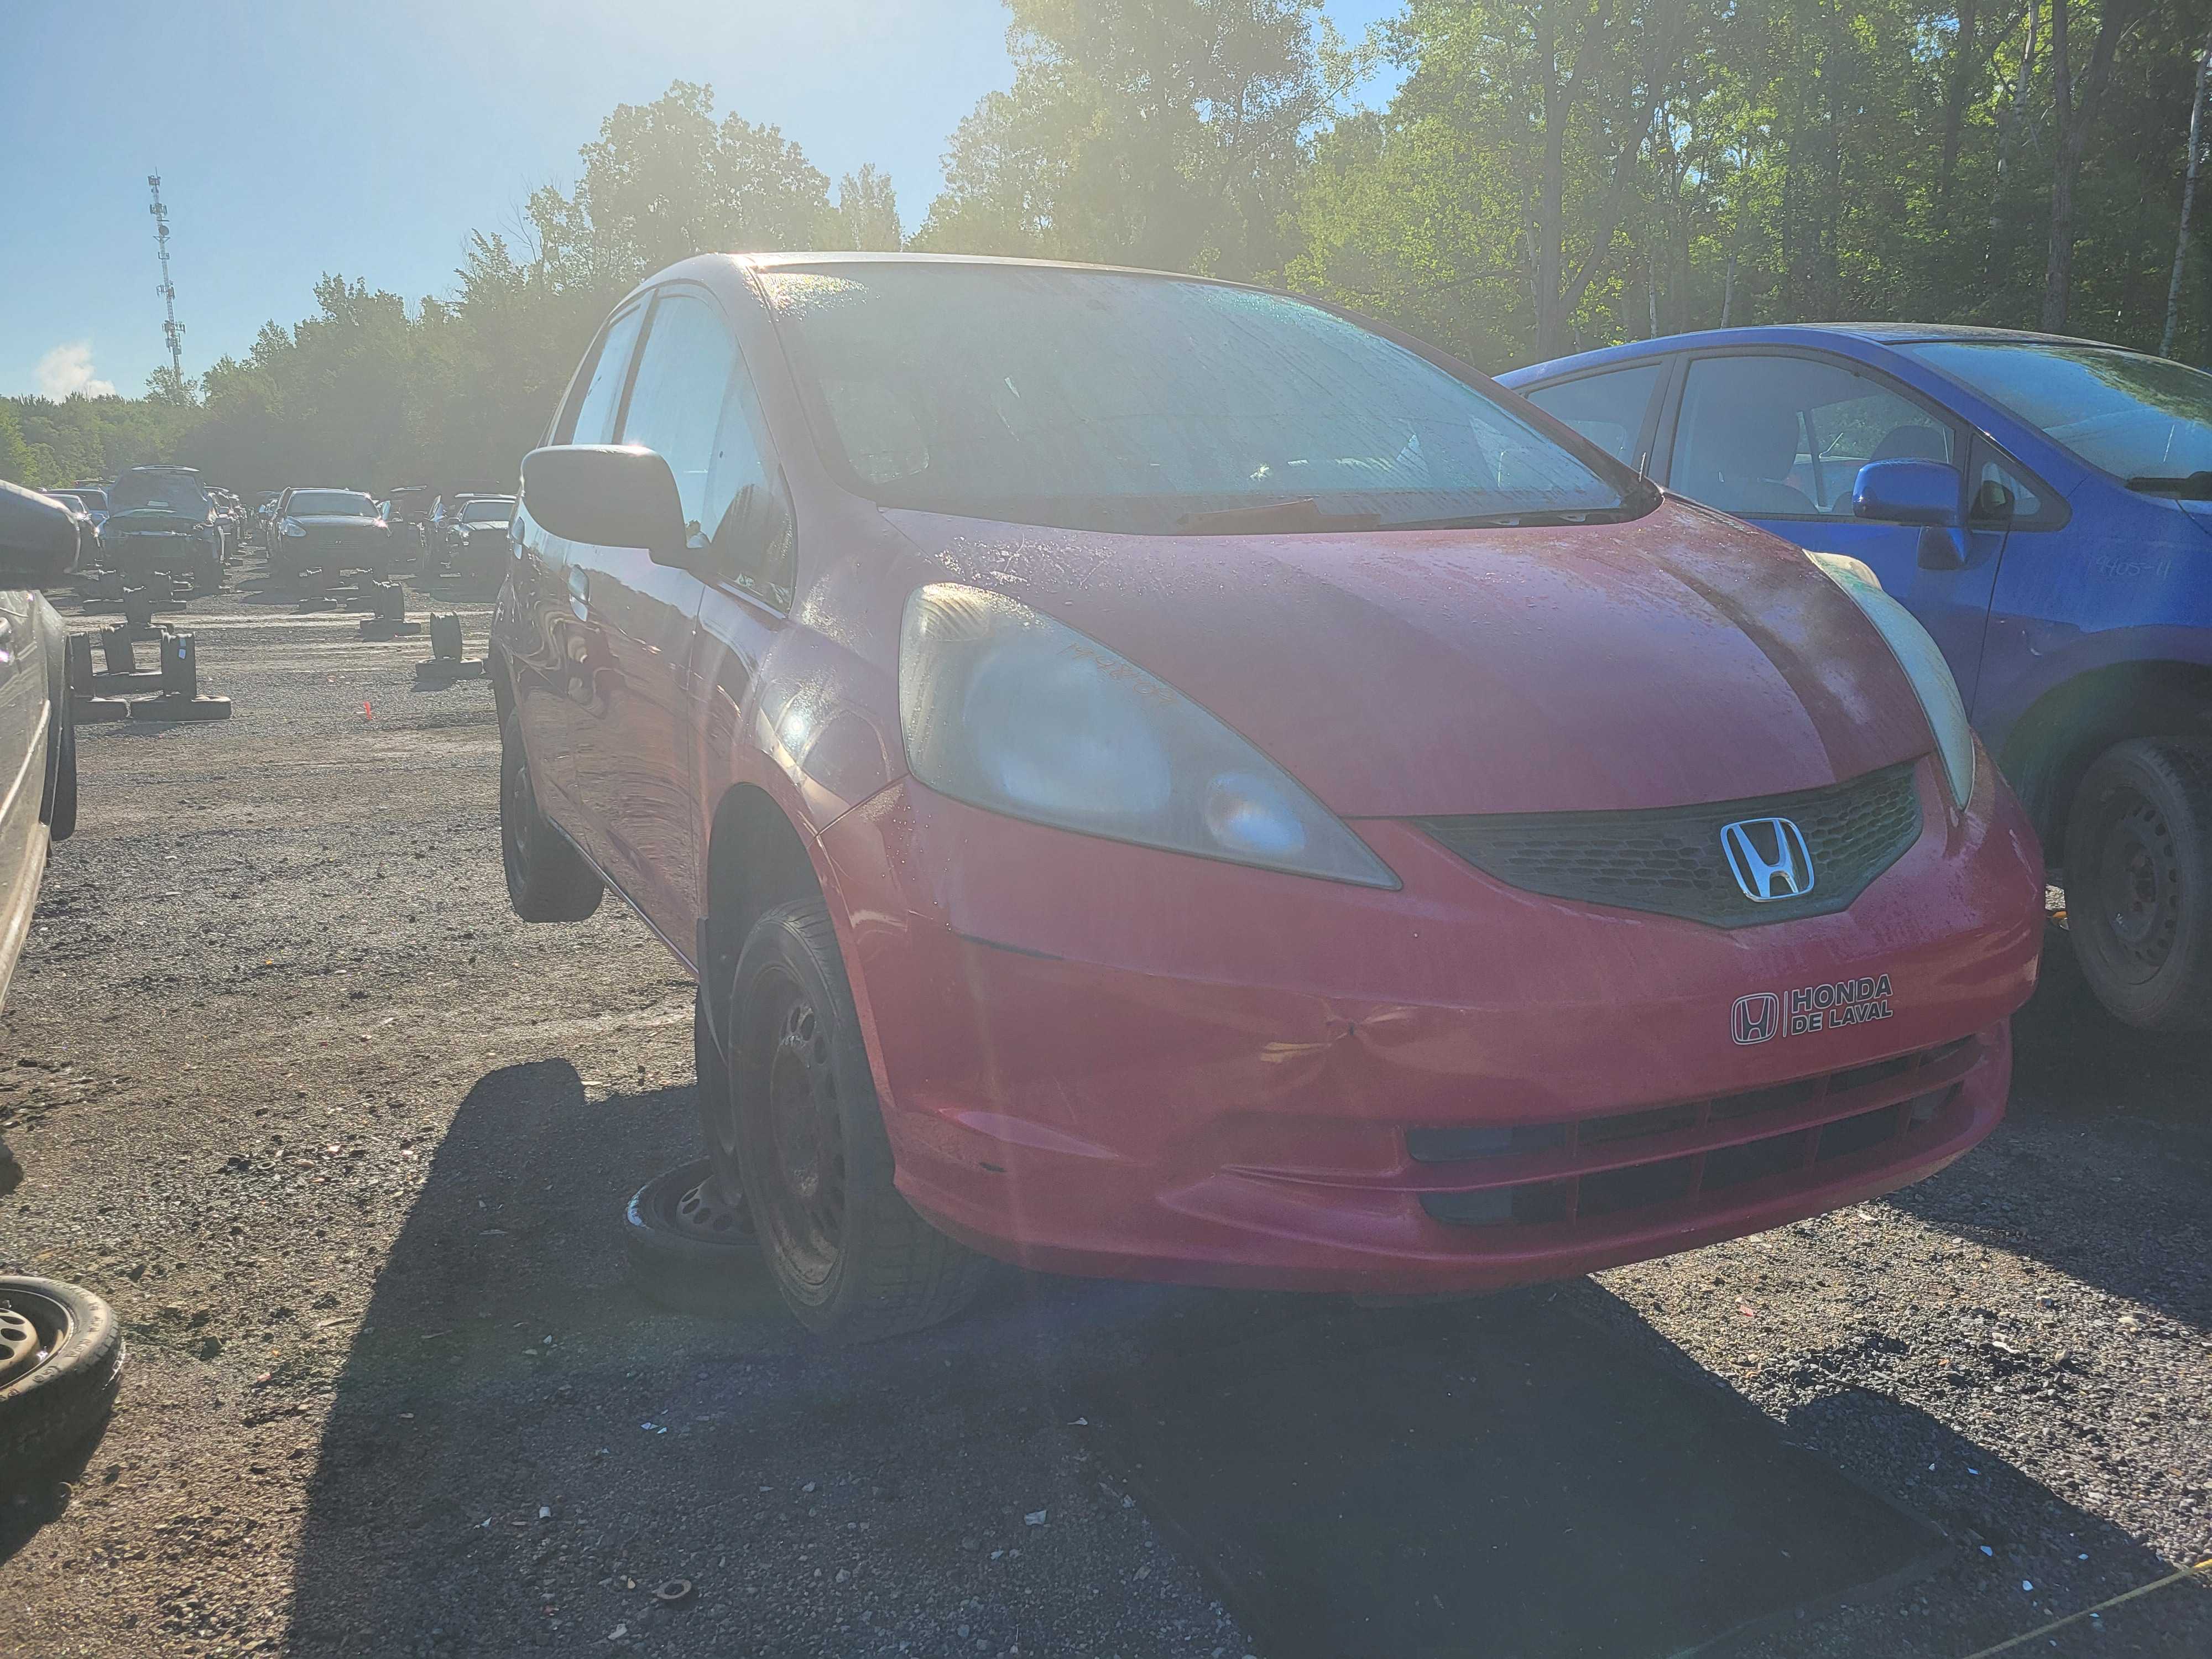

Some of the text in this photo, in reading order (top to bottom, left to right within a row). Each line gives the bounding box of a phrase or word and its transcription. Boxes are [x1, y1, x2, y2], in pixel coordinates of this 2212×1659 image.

[1791, 973, 1893, 1014] HONDA
[1791, 999, 1893, 1035] DE LAVAL
